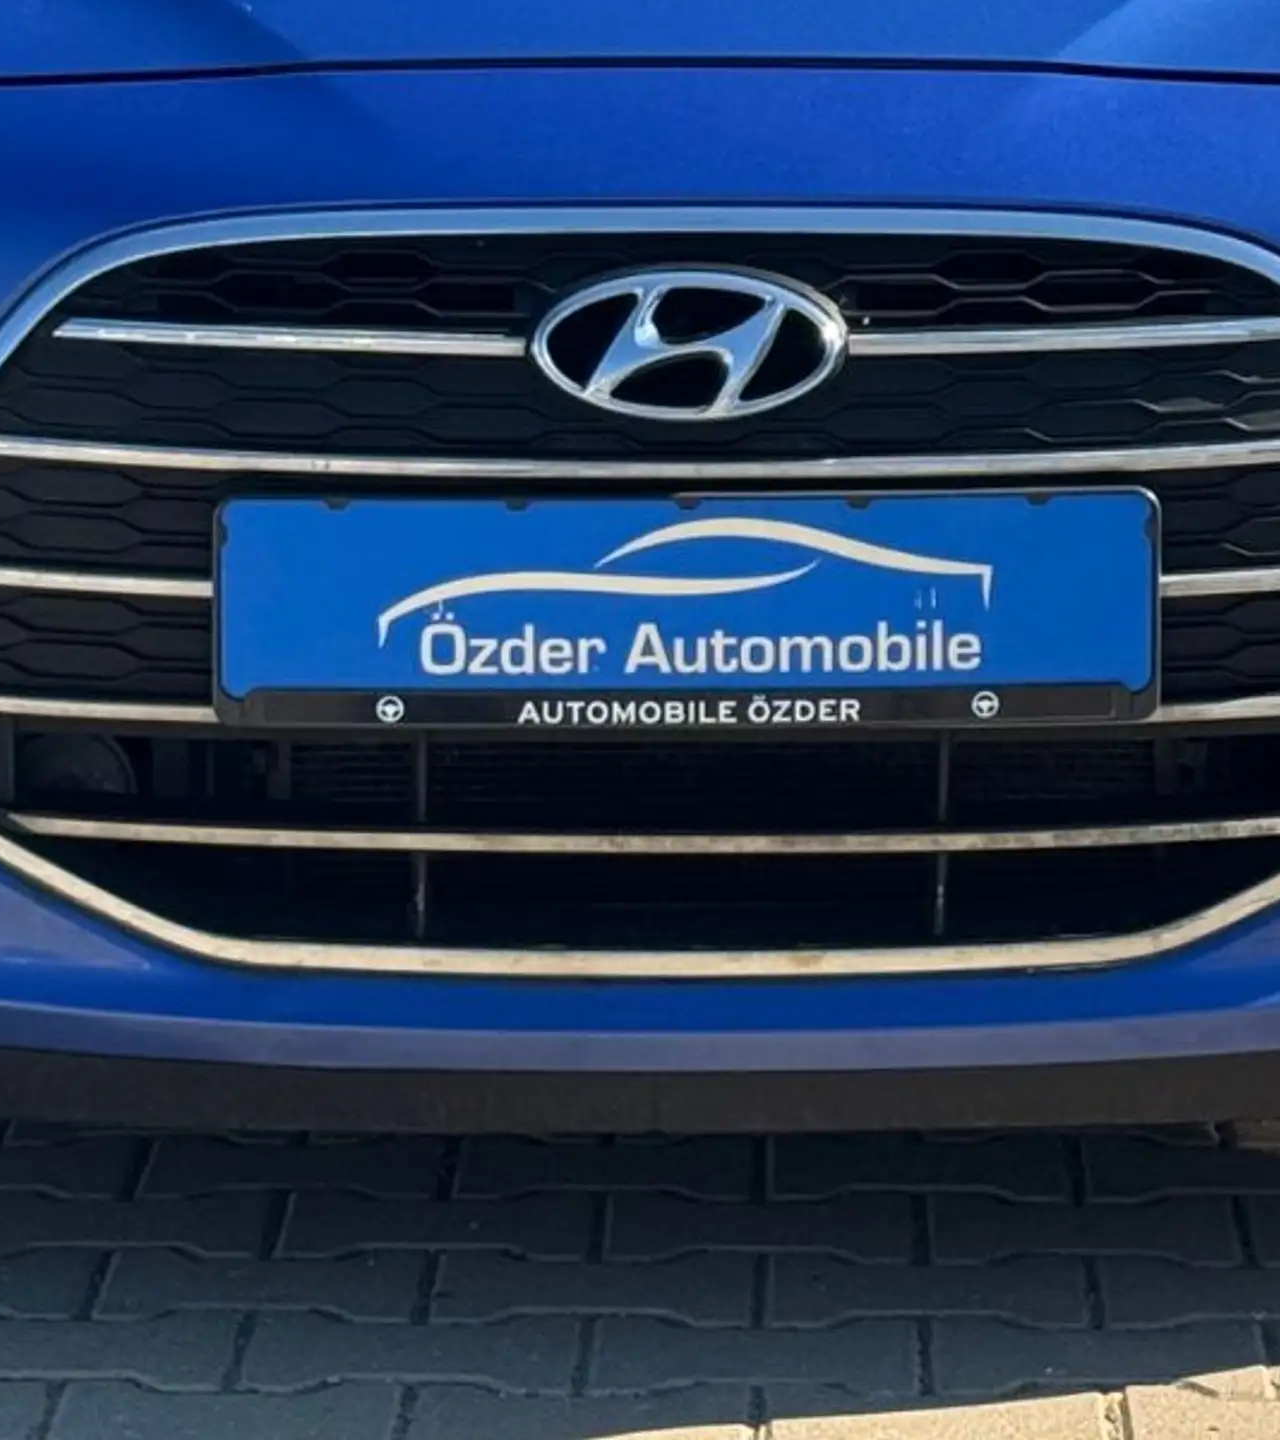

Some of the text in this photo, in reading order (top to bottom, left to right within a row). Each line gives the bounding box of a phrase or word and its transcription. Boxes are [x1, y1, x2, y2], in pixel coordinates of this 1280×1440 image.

[420, 610, 983, 676] Özder Automobile
[516, 694, 861, 726] AUTOMOBILE ÖZDER
